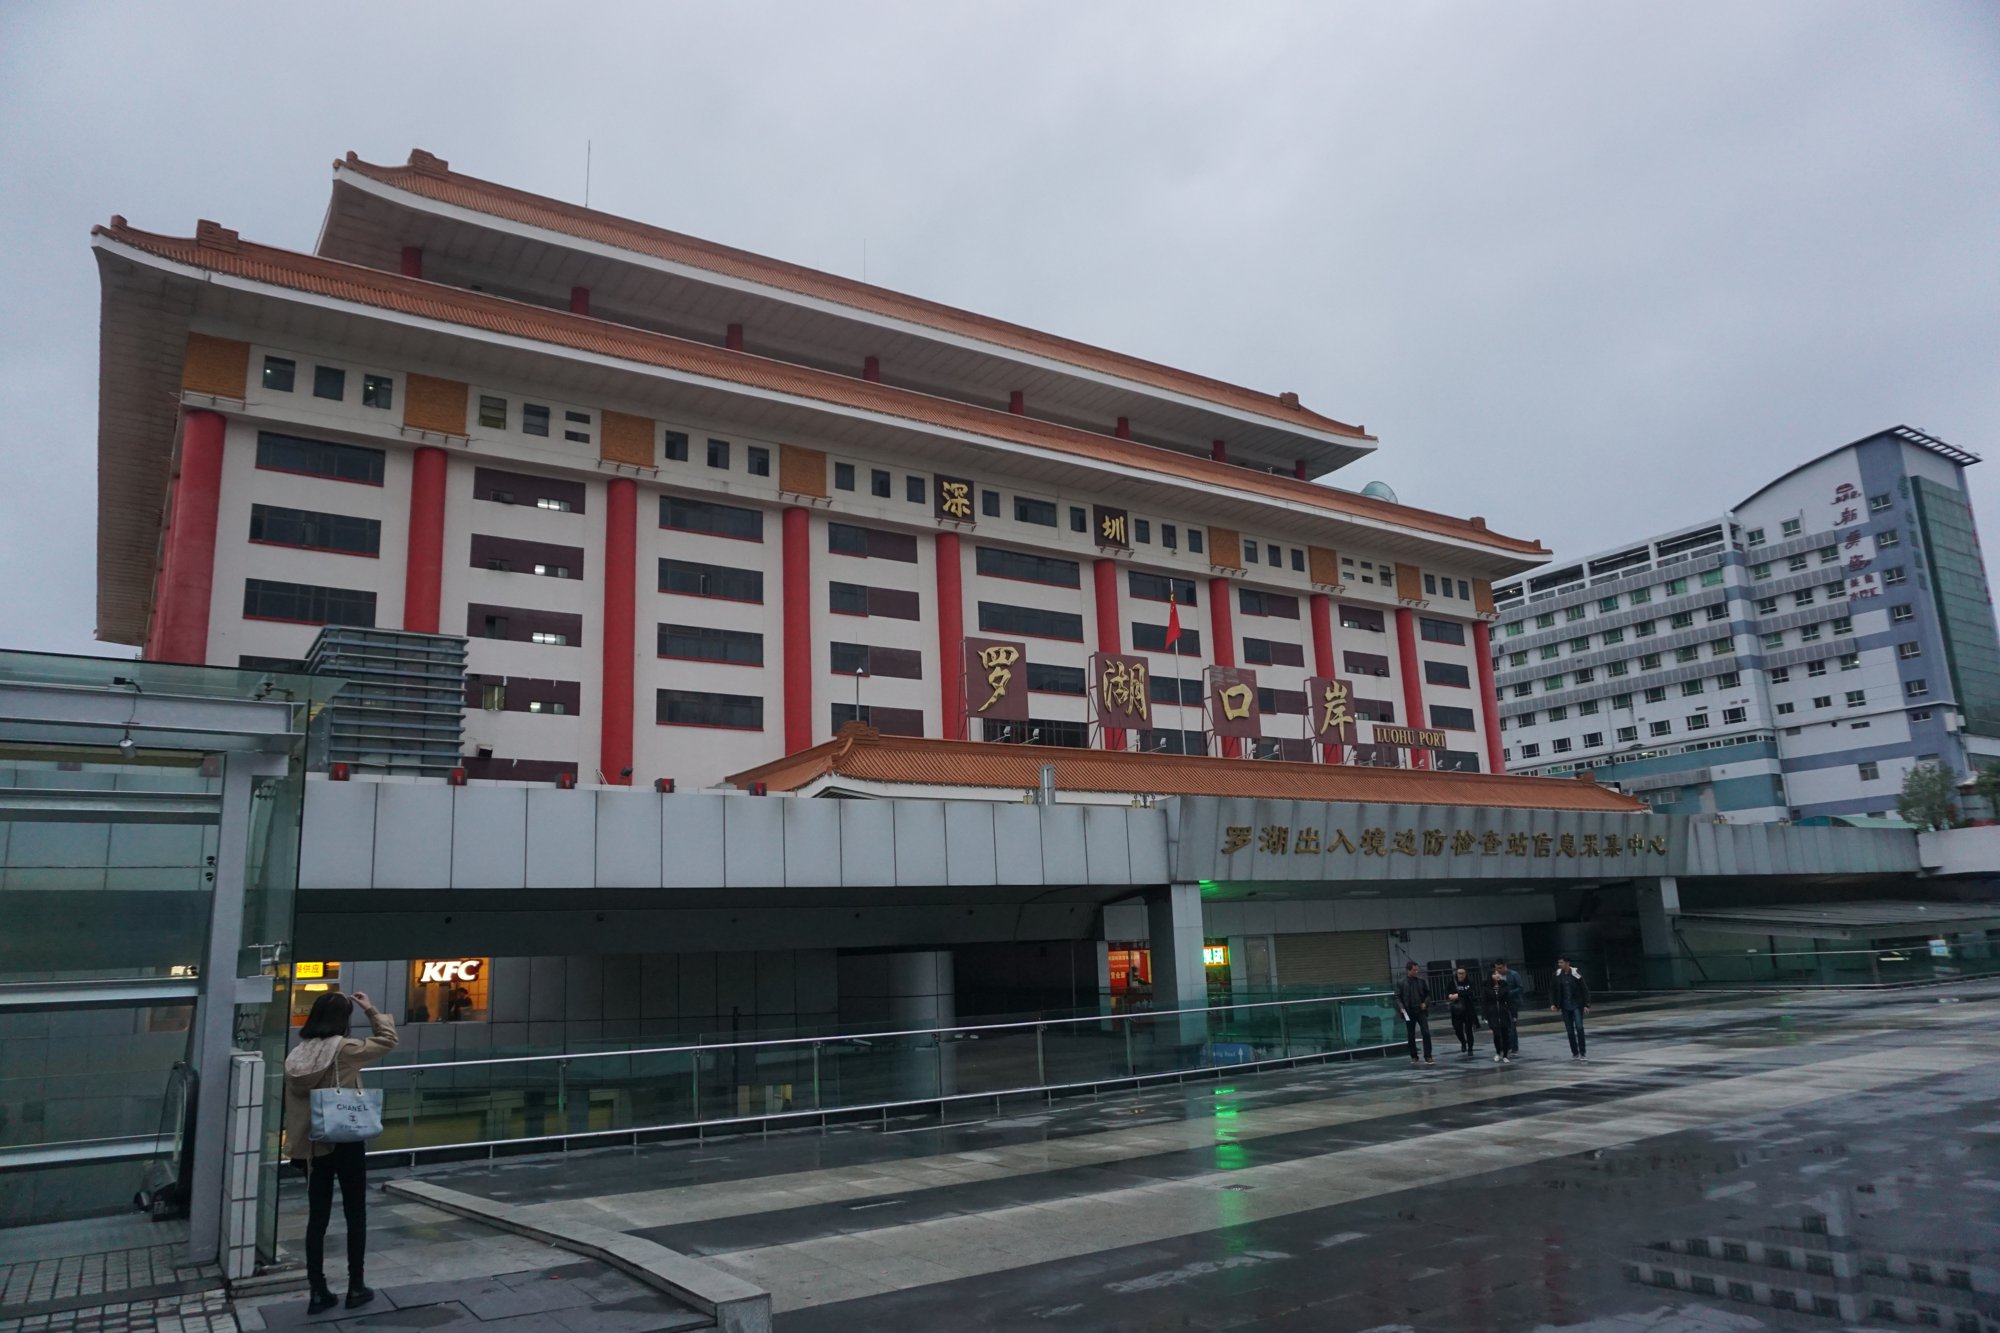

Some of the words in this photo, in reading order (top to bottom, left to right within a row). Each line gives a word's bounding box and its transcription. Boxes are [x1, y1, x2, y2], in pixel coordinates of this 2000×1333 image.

[1376, 727, 1414, 745] LUOHU
[1418, 730, 1446, 747] PORT
[420, 960, 480, 982] KFC
[336, 1103, 369, 1112] CHANEL
